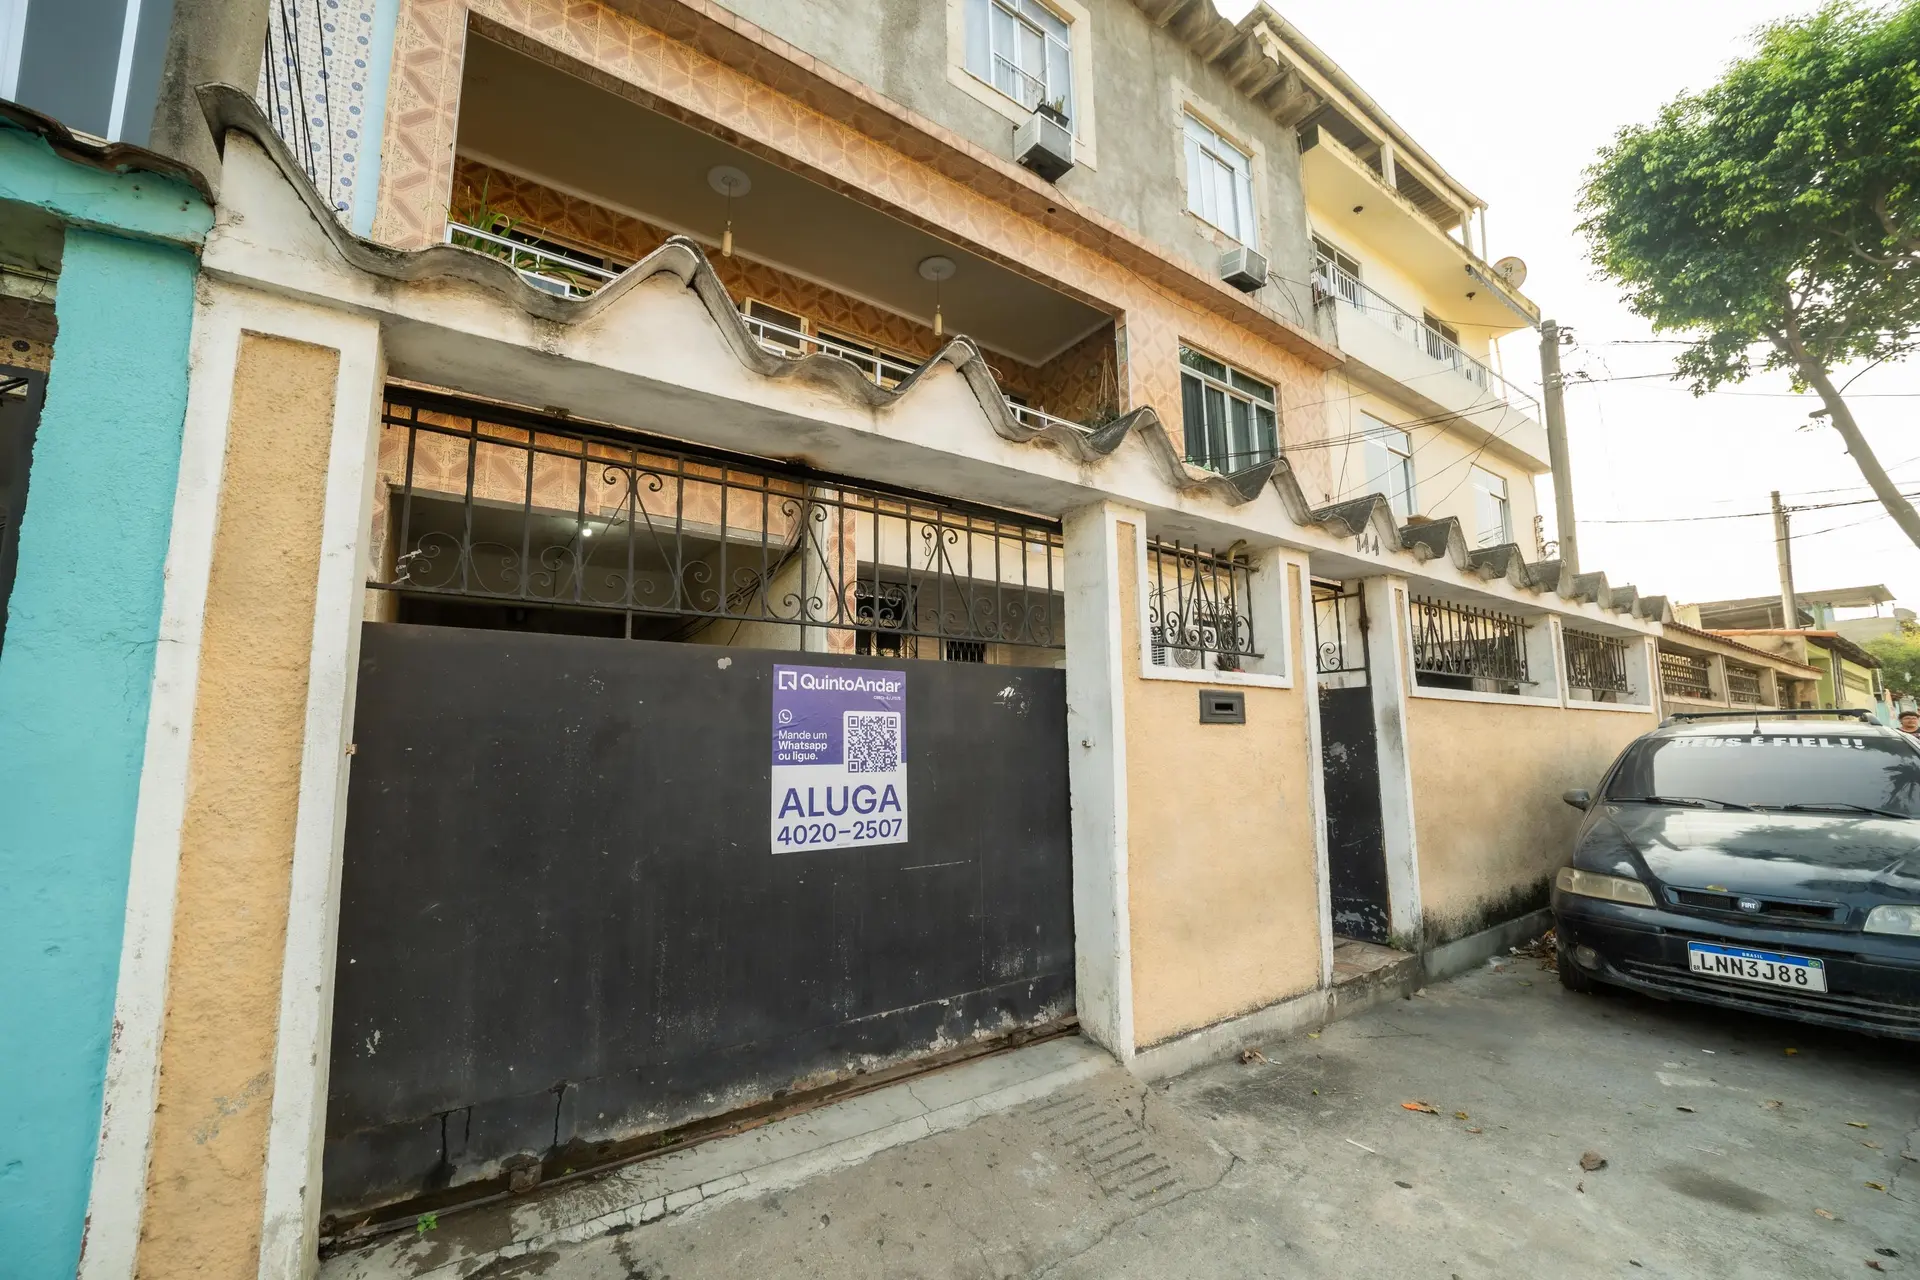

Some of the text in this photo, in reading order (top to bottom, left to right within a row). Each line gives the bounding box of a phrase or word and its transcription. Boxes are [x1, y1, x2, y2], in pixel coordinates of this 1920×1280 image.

[1354, 532, 1379, 557] 144
[800, 673, 901, 693] QuintoAndar
[778, 730, 828, 740] Mande um
[1750, 736, 1765, 747] É
[1773, 737, 1834, 748] FIEL
[778, 740, 828, 752] Whatsapp
[792, 751, 819, 763] ligue.
[778, 784, 902, 819] ALUGA
[777, 818, 903, 846] 4020-2507
[1741, 952, 1764, 960] BRASIL
[1700, 953, 1808, 986] LNN3J88
